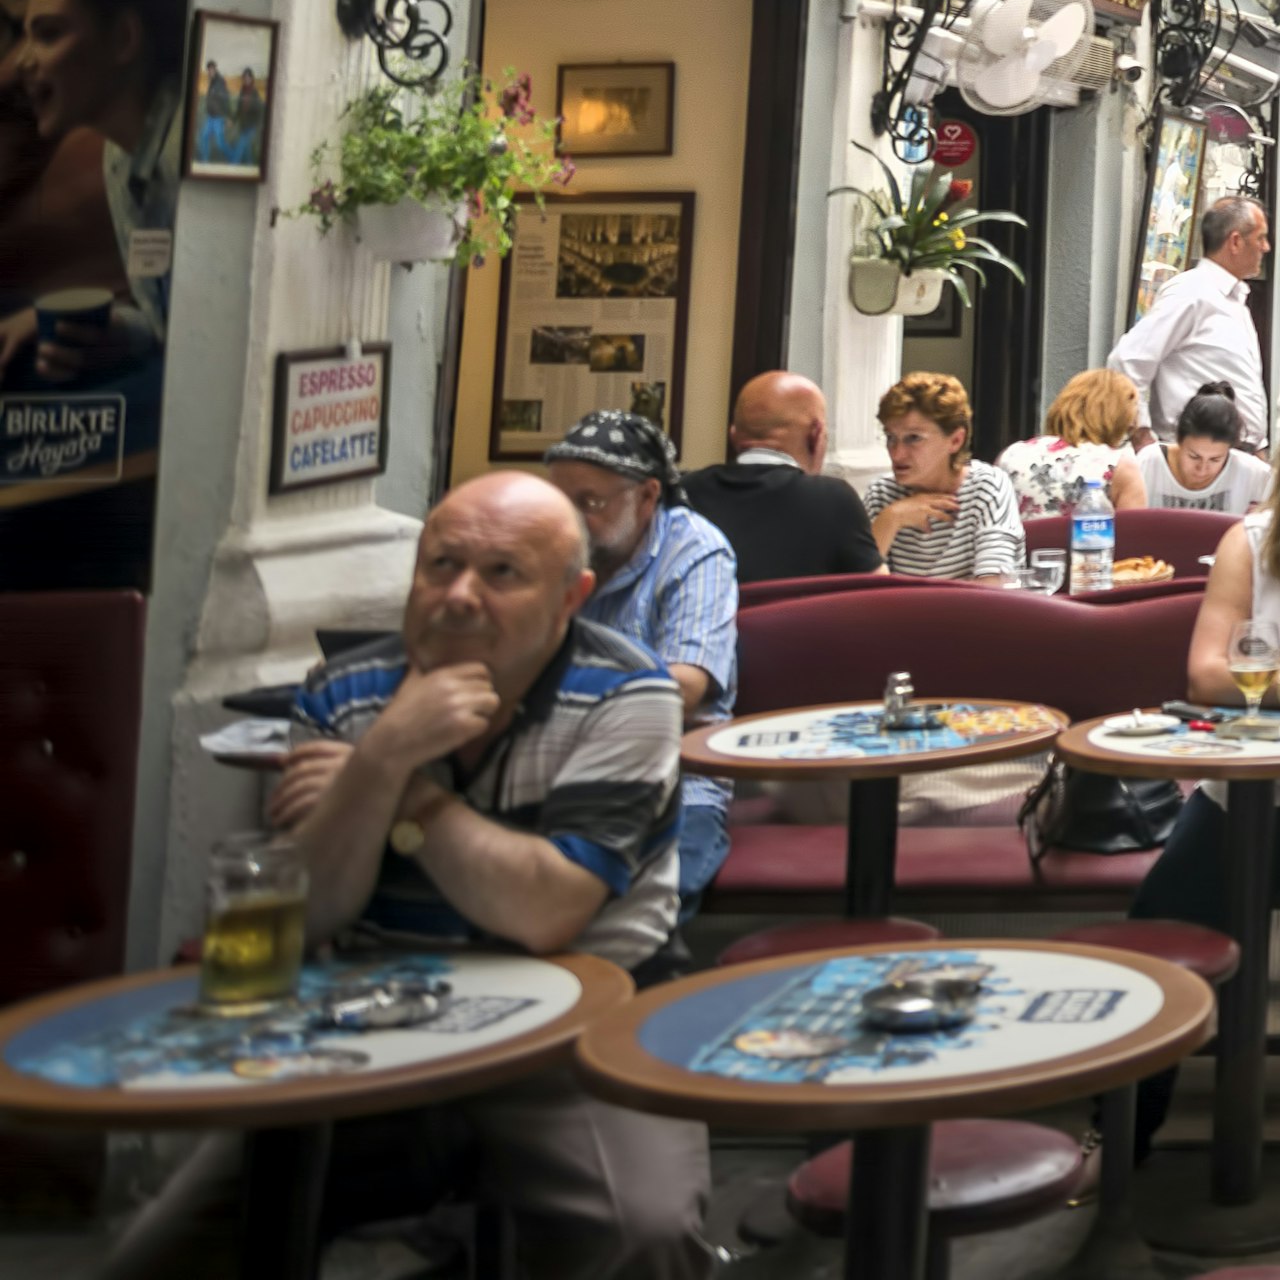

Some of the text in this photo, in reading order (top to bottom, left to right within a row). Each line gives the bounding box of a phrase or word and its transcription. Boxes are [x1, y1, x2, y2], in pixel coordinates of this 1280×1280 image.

[298, 363, 376, 398] ESPRESSO
[290, 394, 380, 435] CAPUCCINO
[289, 431, 378, 472] CAFELATTE
